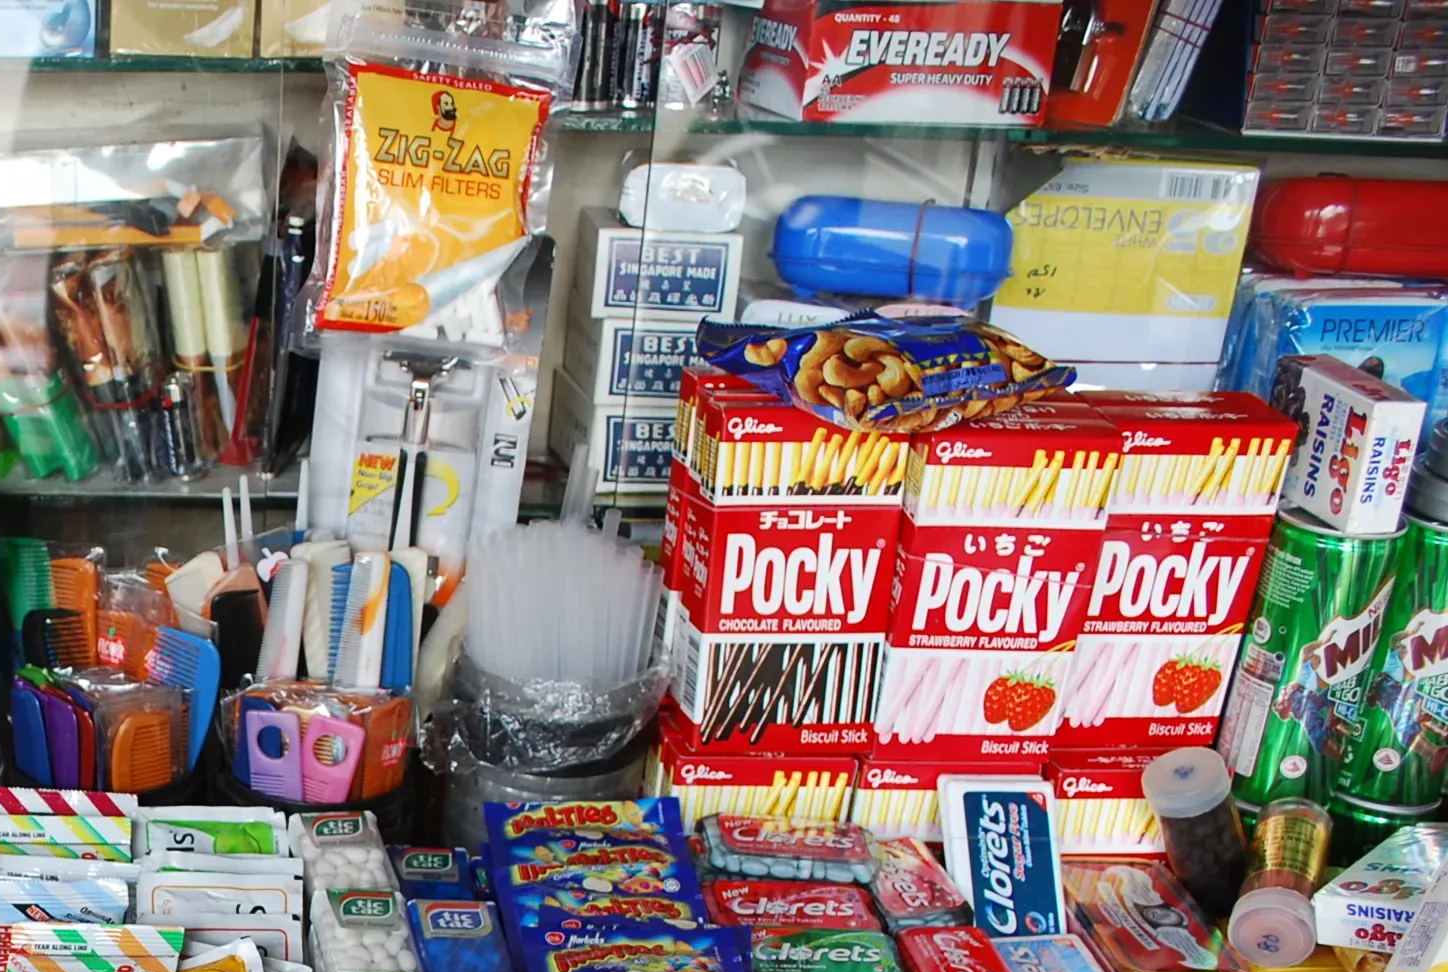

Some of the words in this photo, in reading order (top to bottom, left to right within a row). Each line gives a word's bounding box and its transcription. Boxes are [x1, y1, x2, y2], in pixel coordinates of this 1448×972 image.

[835, 14, 881, 23] QUANTITY
[846, 30, 1010, 66] EVEREADY
[413, 73, 451, 85] SAFETY
[454, 79, 492, 91] SEALED
[890, 73, 925, 84] SUPER
[928, 74, 962, 84] HEAVY
[964, 75, 992, 84] DUTY
[374, 127, 510, 179] ZIG-ZAG
[378, 169, 424, 189] SLIM
[430, 177, 501, 200] FILTERS
[640, 247, 700, 264] BEST
[619, 262, 682, 278] SINGAPORE
[686, 267, 716, 280] MADE
[1320, 319, 1425, 343] PREMIER
[1304, 394, 1336, 497] RAISINS
[359, 452, 396, 471] NEW
[759, 511, 851, 531] チョコレート
[964, 533, 1051, 556] いちご
[722, 532, 883, 624] Pocky
[1086, 529, 1250, 624] Pocky
[912, 553, 1080, 643] Pocky
[719, 618, 780, 632] CHOCOLATE
[783, 618, 842, 632] FLAVOURED
[908, 635, 976, 649] STRAWBERRY
[978, 636, 1037, 650] FLAVOURED
[800, 728, 837, 746] Biscuit
[839, 729, 868, 745] Stick
[1008, 803, 1021, 836] Free
[979, 798, 1018, 934] Clorets
[1011, 836, 1026, 881] Sugar
[26, 905, 50, 921] NEW
[568, 930, 605, 947] Horlicks
